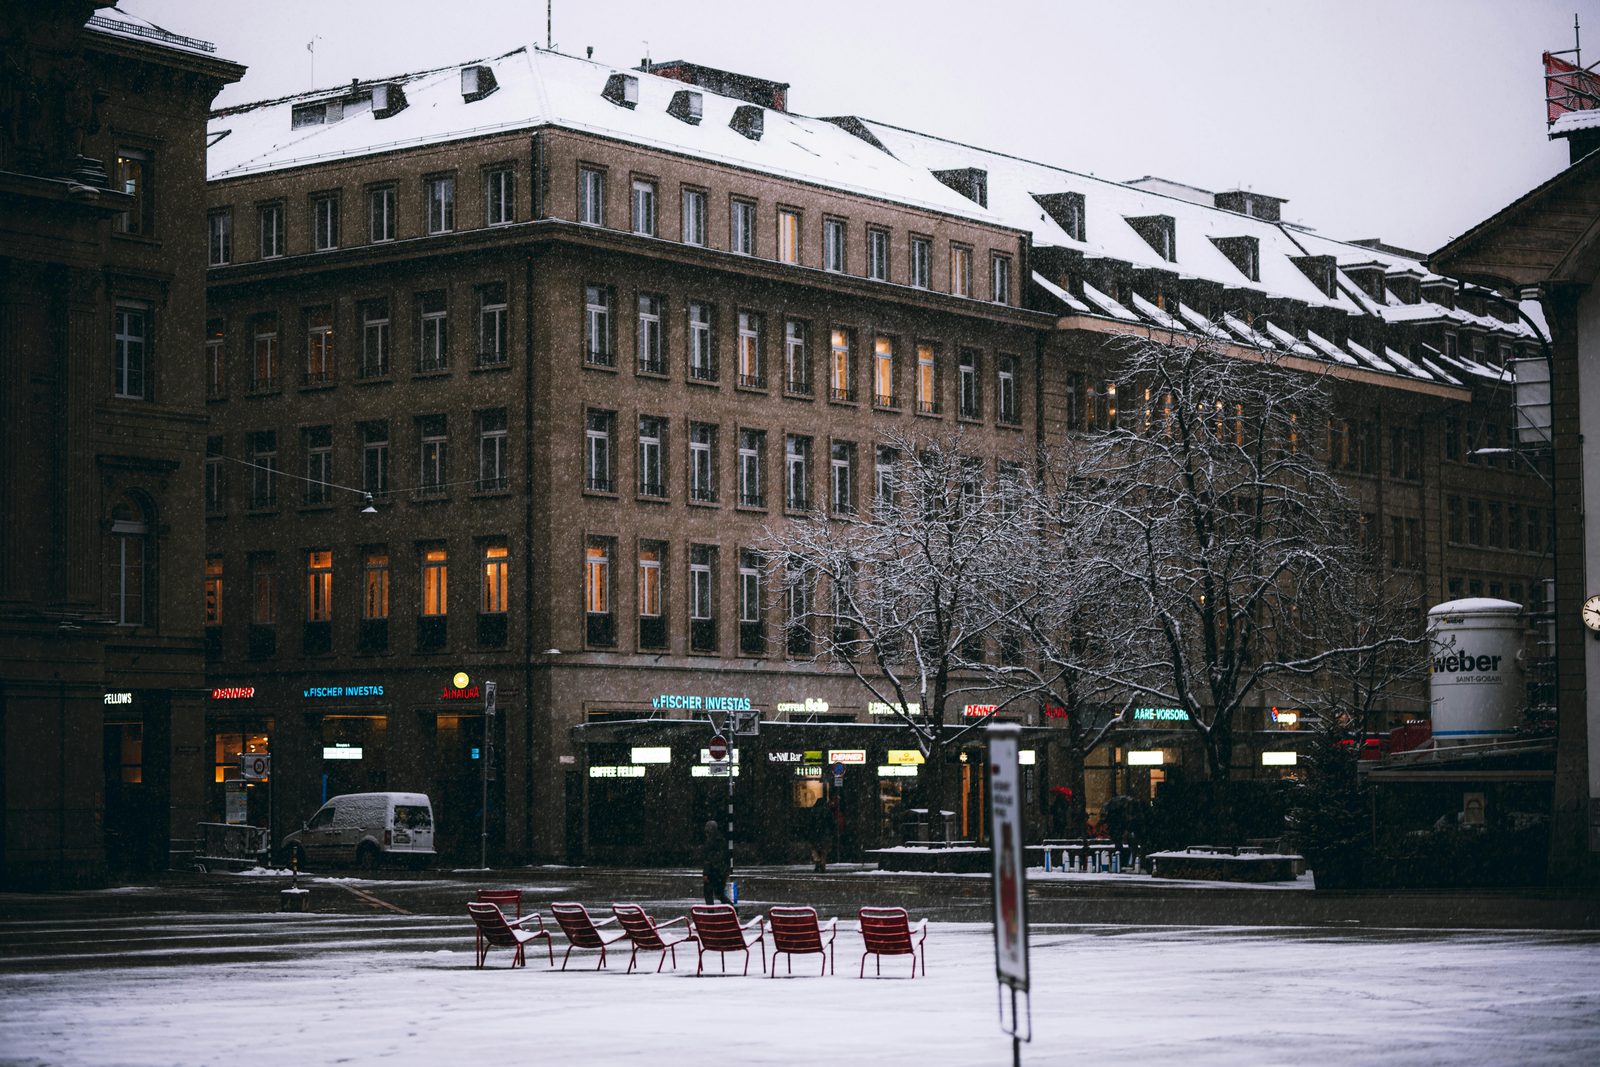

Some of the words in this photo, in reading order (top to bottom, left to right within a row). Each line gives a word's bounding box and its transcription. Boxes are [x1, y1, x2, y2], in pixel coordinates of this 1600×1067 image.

[1433, 650, 1502, 673] weber
[211, 687, 255, 699] DENNER
[303, 687, 342, 698] v.FISCHER
[345, 685, 384, 696] INVESTAS
[652, 694, 702, 709] v.FISCHER
[704, 696, 751, 711] INVESTAS
[1133, 708, 1154, 720] AARE
